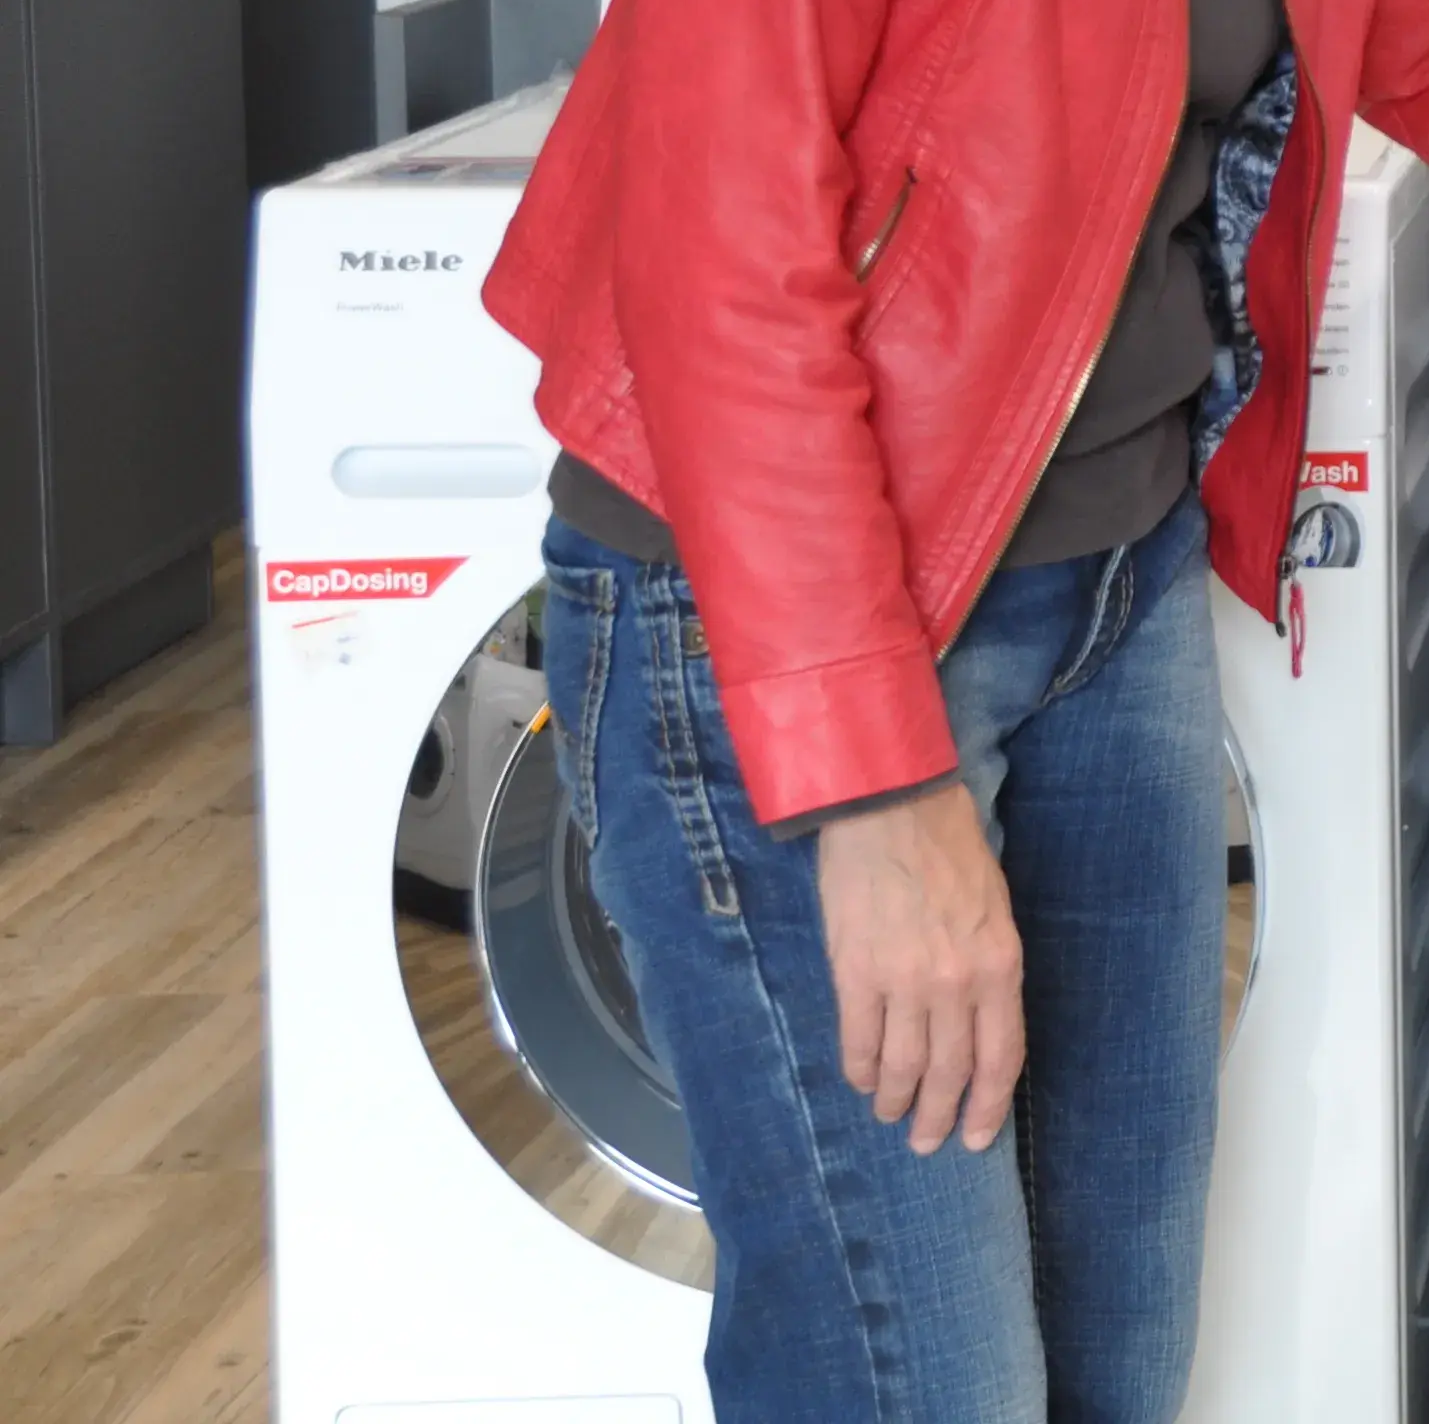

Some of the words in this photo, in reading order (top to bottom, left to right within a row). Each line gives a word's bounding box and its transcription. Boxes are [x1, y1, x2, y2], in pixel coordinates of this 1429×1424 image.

[340, 250, 463, 272] Miele
[1301, 460, 1359, 484] ash
[272, 567, 429, 598] CapDosing
